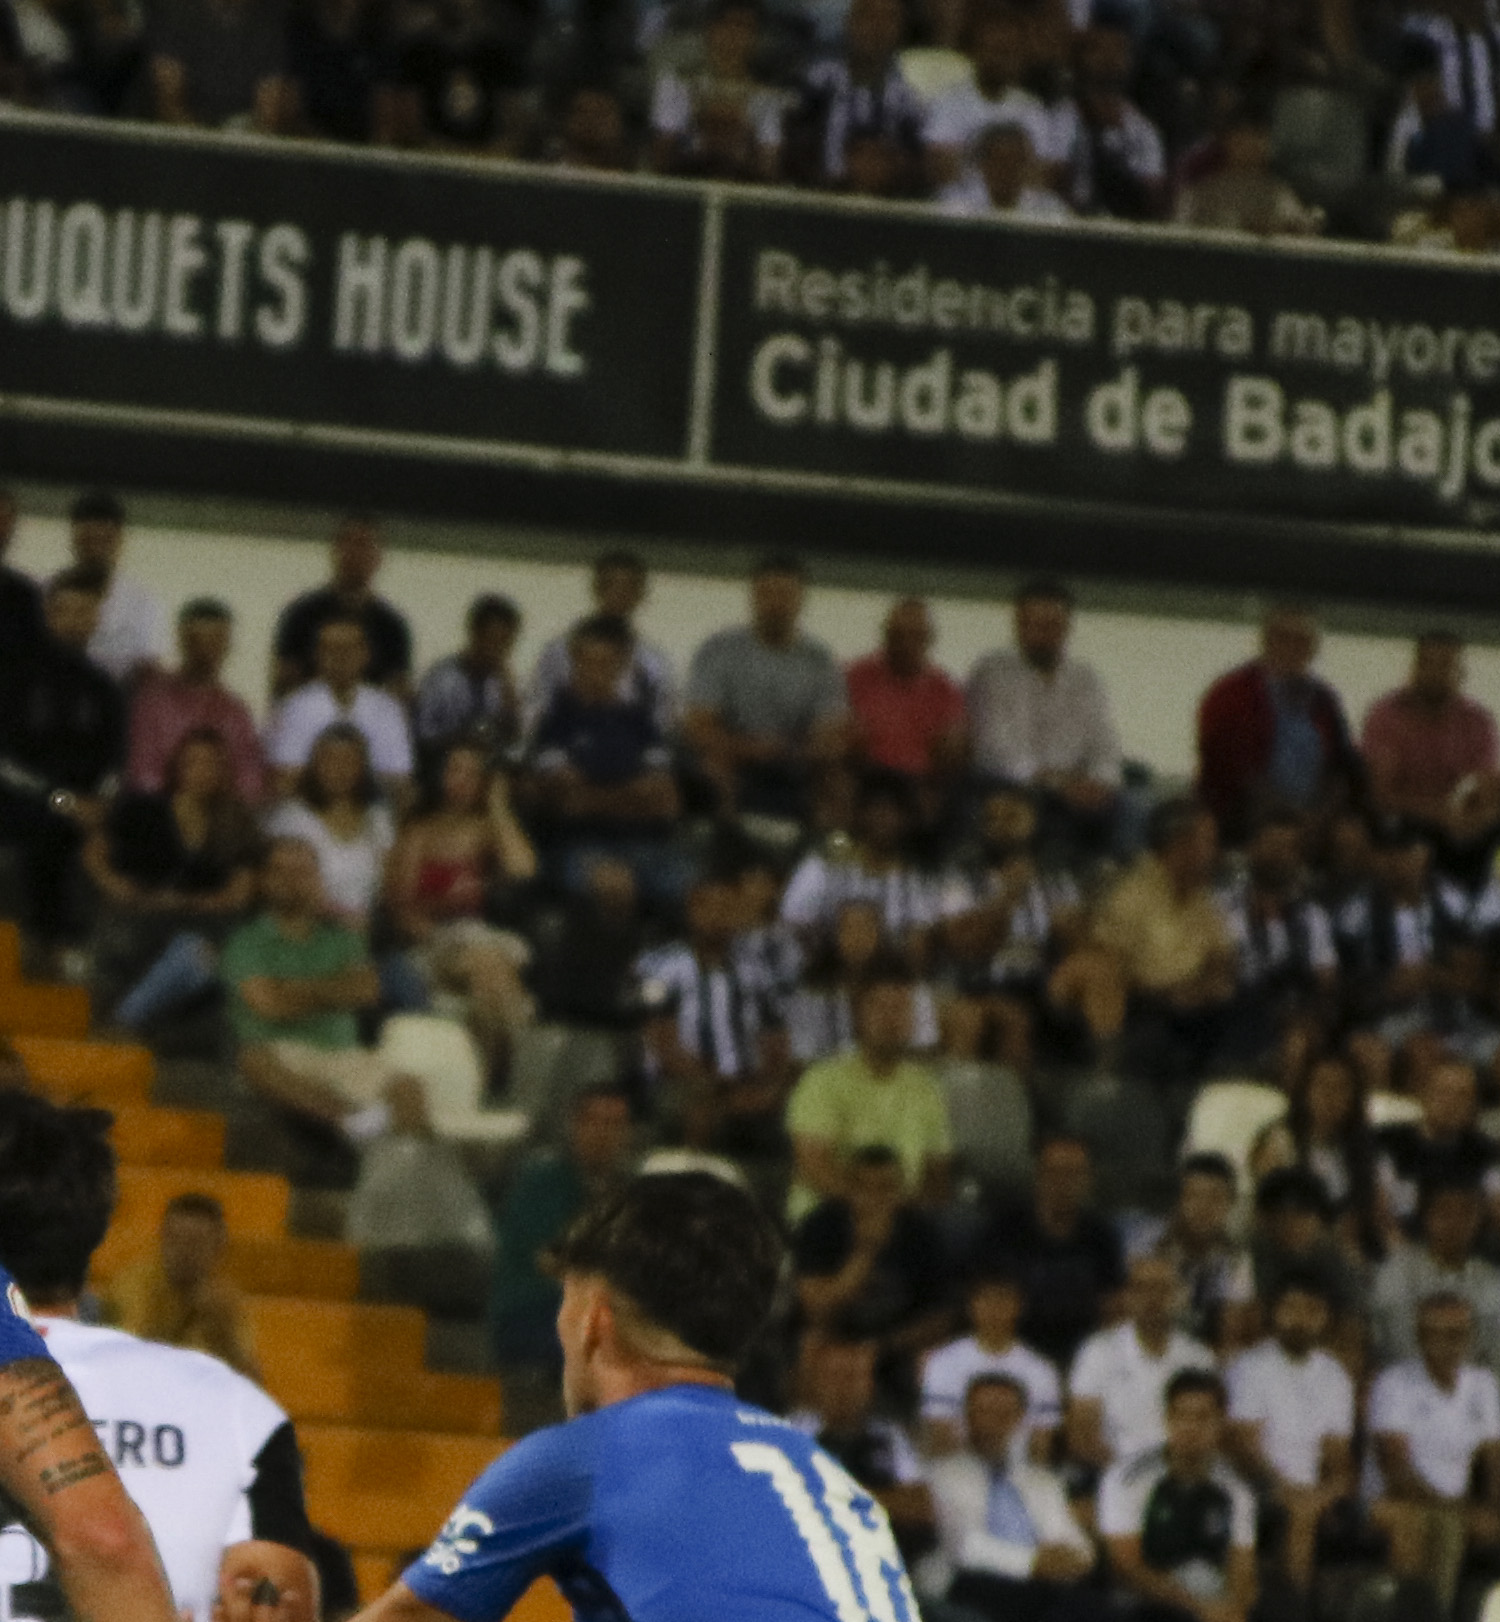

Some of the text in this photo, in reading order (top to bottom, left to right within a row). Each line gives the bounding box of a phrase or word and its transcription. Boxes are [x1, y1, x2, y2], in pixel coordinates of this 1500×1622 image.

[333, 231, 590, 377] HOUSE
[754, 248, 1095, 346] Residencia
[1112, 292, 1256, 358] para
[748, 334, 1061, 445] Ciudad
[1086, 366, 1195, 461] de
